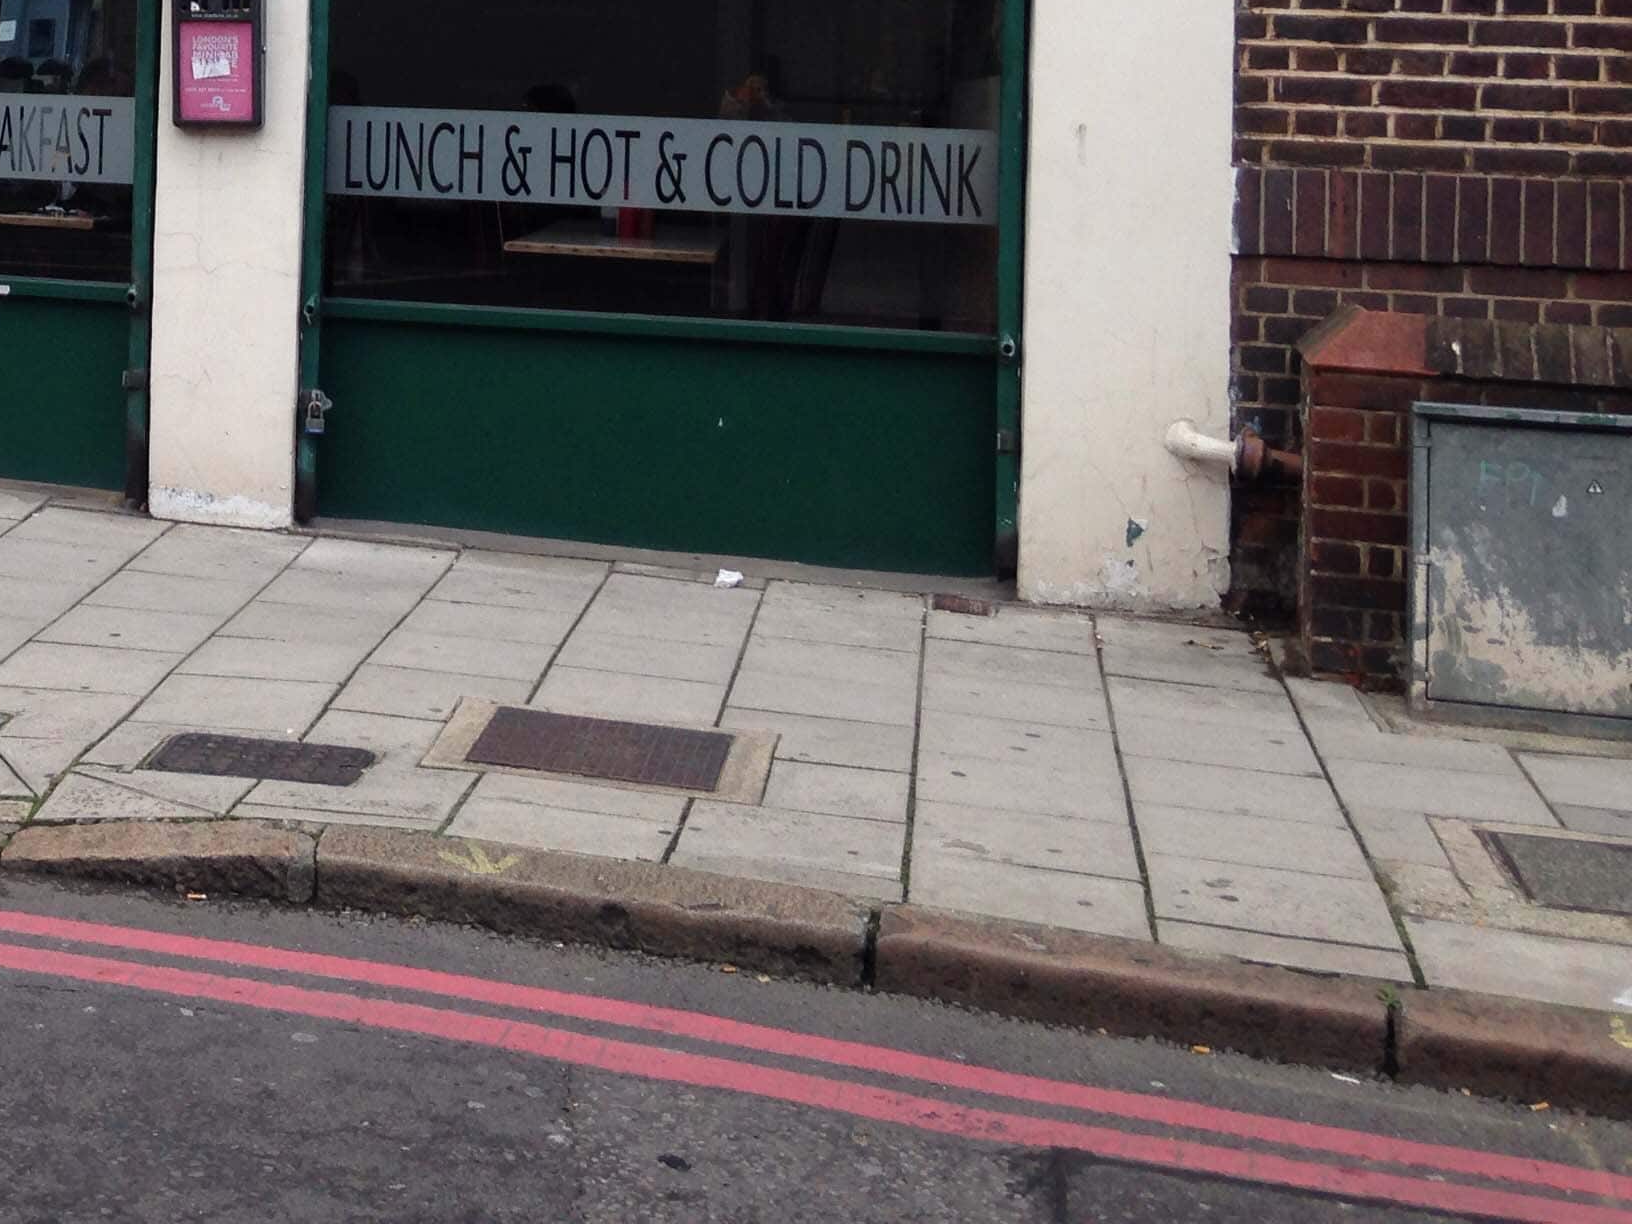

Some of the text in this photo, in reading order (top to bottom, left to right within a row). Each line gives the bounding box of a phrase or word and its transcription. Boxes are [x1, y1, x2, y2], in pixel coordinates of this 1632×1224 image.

[343, 118, 984, 218] LUNCH & HOT & COLD DRINK
